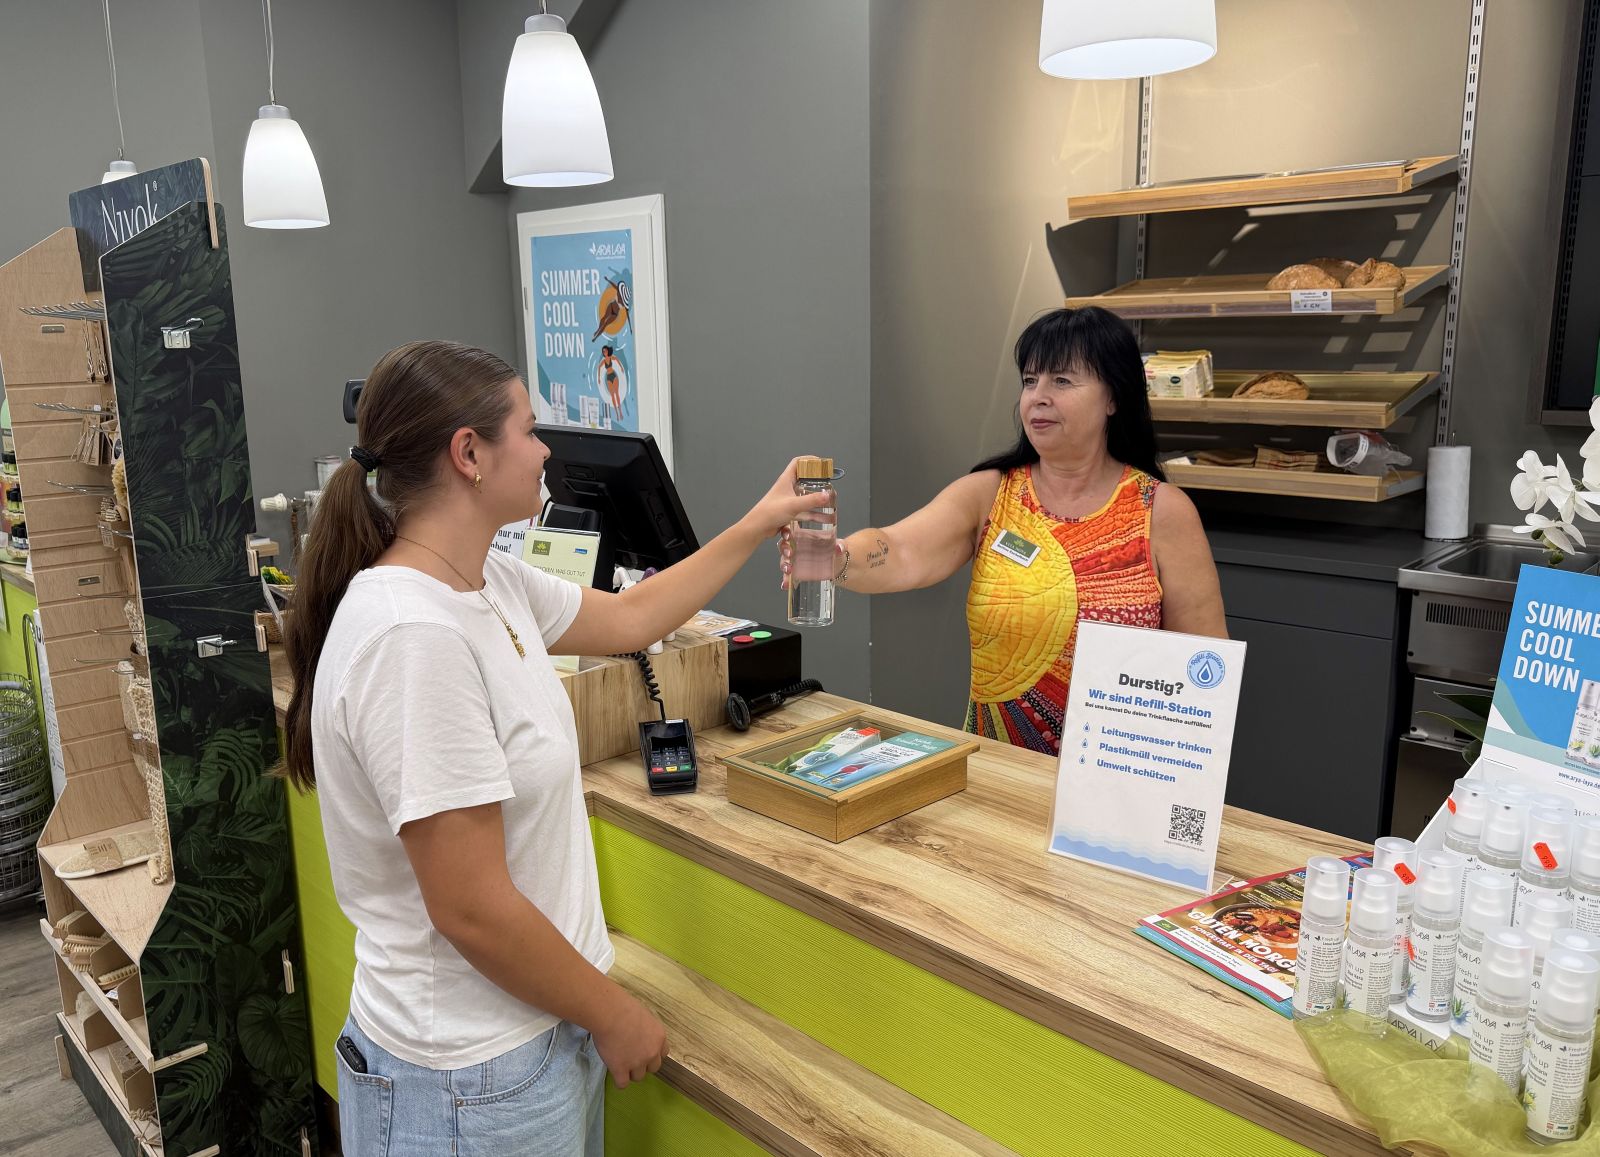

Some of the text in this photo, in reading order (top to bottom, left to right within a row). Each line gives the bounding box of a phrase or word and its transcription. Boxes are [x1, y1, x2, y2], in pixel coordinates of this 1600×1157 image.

[541, 269, 600, 296] SUMMER
[543, 301, 579, 327] COOL
[545, 332, 585, 358] DOWN
[1519, 628, 1575, 663] COOL
[1119, 673, 1184, 696] Durstig?
[1513, 655, 1581, 693] DOWN
[1089, 688, 1212, 718] Wir sind Refill-Station
[1101, 726, 1212, 755] Leitungswasser trinken
[1099, 742, 1203, 770] Plastikmüll vermeiden
[1097, 758, 1176, 782] Umwelt schützen
[1188, 911, 1242, 939] GUTEN
[1480, 1014, 1496, 1030] LAYA
[1484, 1037, 1494, 1046] up
[1536, 1038, 1552, 1052] LAYA
[1538, 1058, 1549, 1069] up
